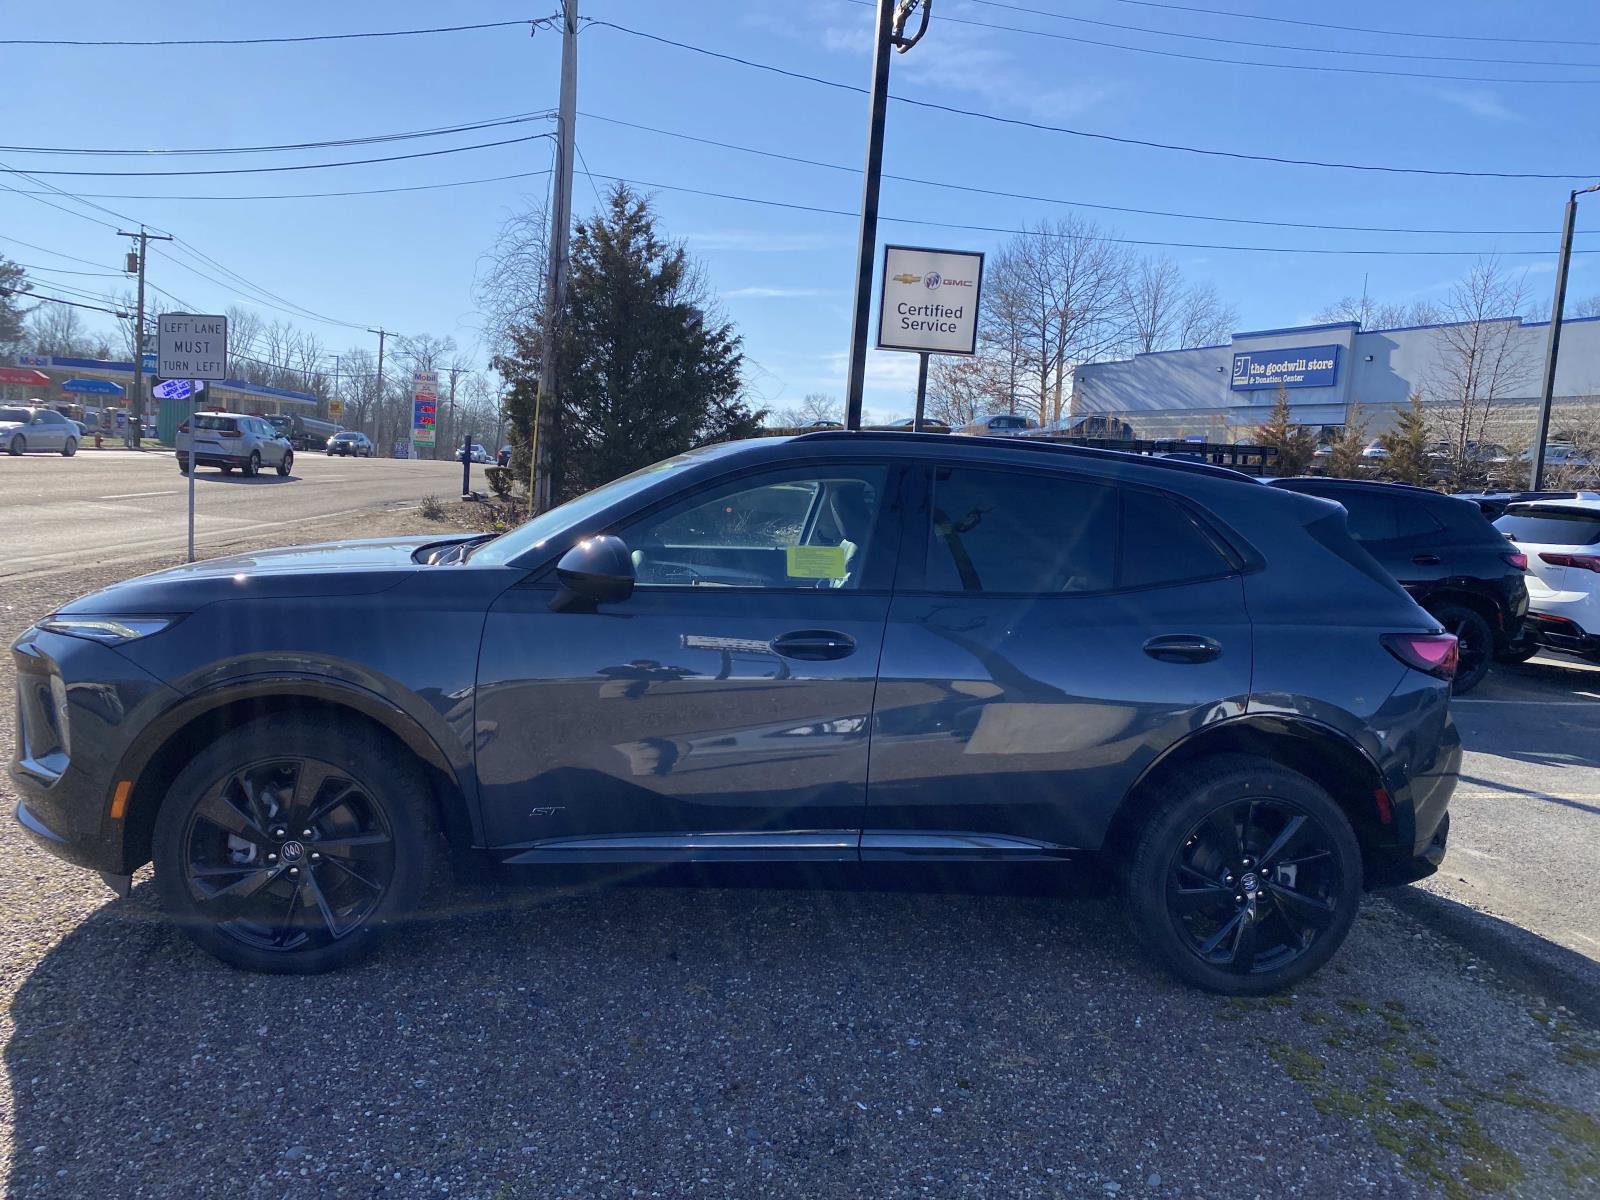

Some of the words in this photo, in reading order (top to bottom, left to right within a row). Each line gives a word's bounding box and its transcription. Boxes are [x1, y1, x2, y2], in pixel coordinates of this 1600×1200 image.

[942, 278, 973, 287] GMC
[897, 302, 963, 319] Certified
[164, 322, 189, 333] LEFT
[195, 323, 222, 334] LANE
[901, 317, 957, 333] Service
[174, 341, 210, 354] MUST
[19, 356, 48, 366] Mobil
[163, 360, 189, 371] TURN
[196, 361, 221, 372] LEFT
[1250, 363, 1265, 374] the
[1266, 359, 1306, 376] goodwill
[1307, 358, 1333, 371] store
[414, 373, 436, 381] Mobil
[1255, 375, 1282, 384] Donation
[1283, 374, 1304, 383] Center
